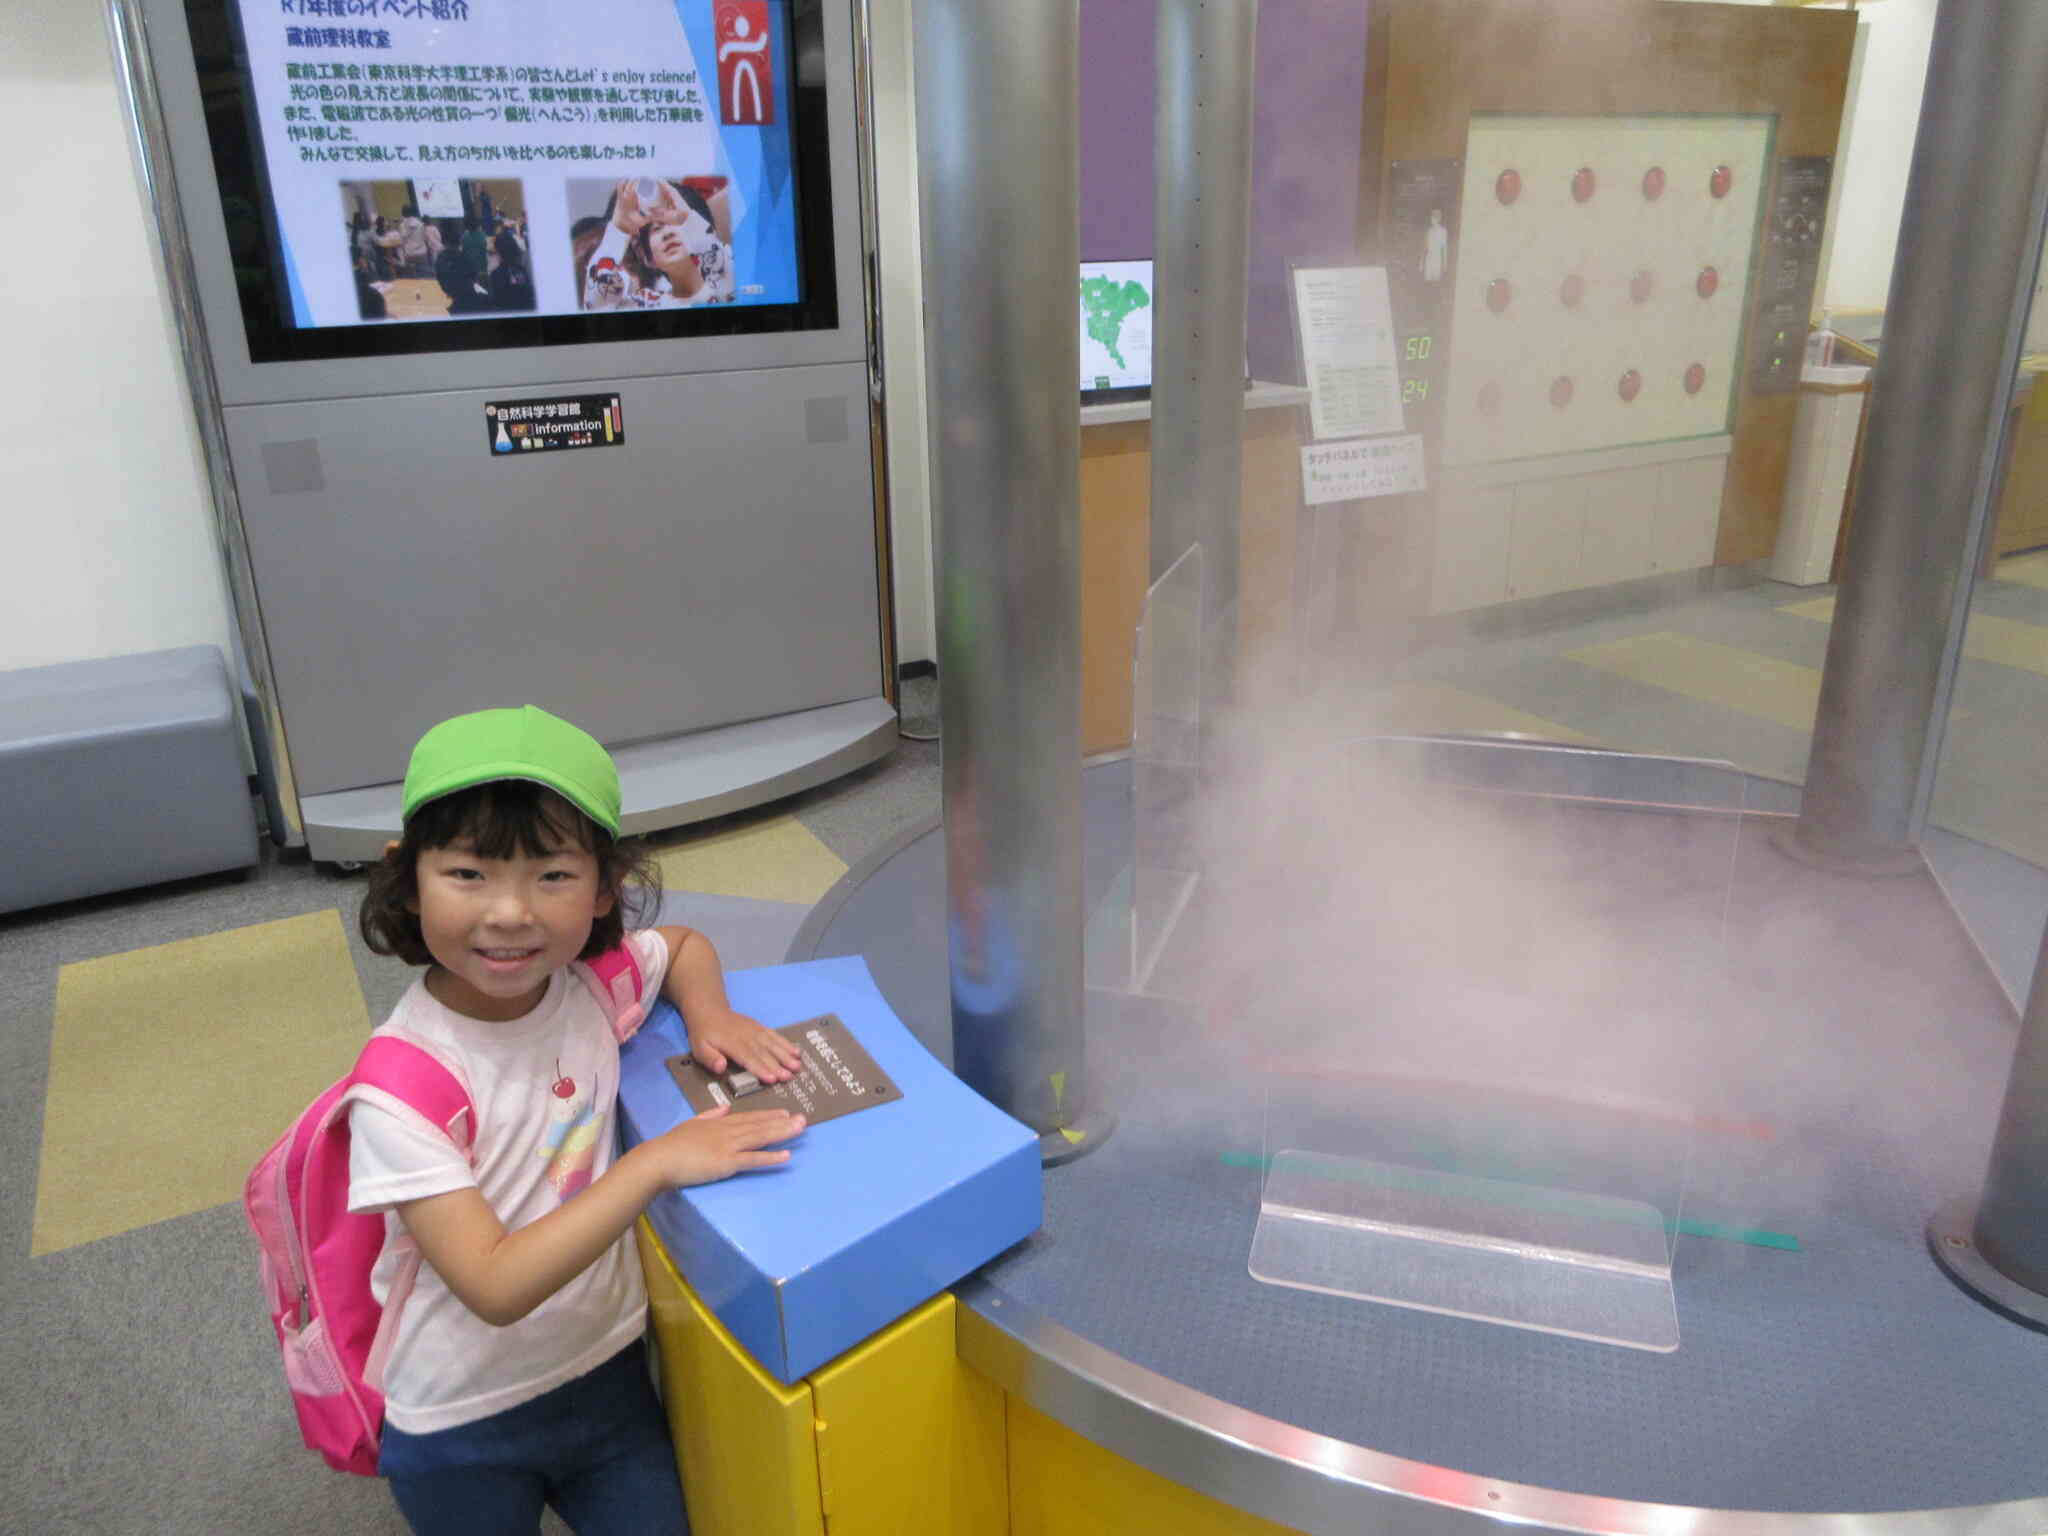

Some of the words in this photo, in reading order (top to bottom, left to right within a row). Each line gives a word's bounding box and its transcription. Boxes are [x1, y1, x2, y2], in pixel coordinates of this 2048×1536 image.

[286, 26, 392, 48] 蔵前理科教室
[612, 71, 645, 84] enjoy
[650, 69, 696, 83] science!
[287, 125, 359, 142] 作りました。
[1406, 336, 1432, 360] 50
[1403, 380, 1429, 402] 24
